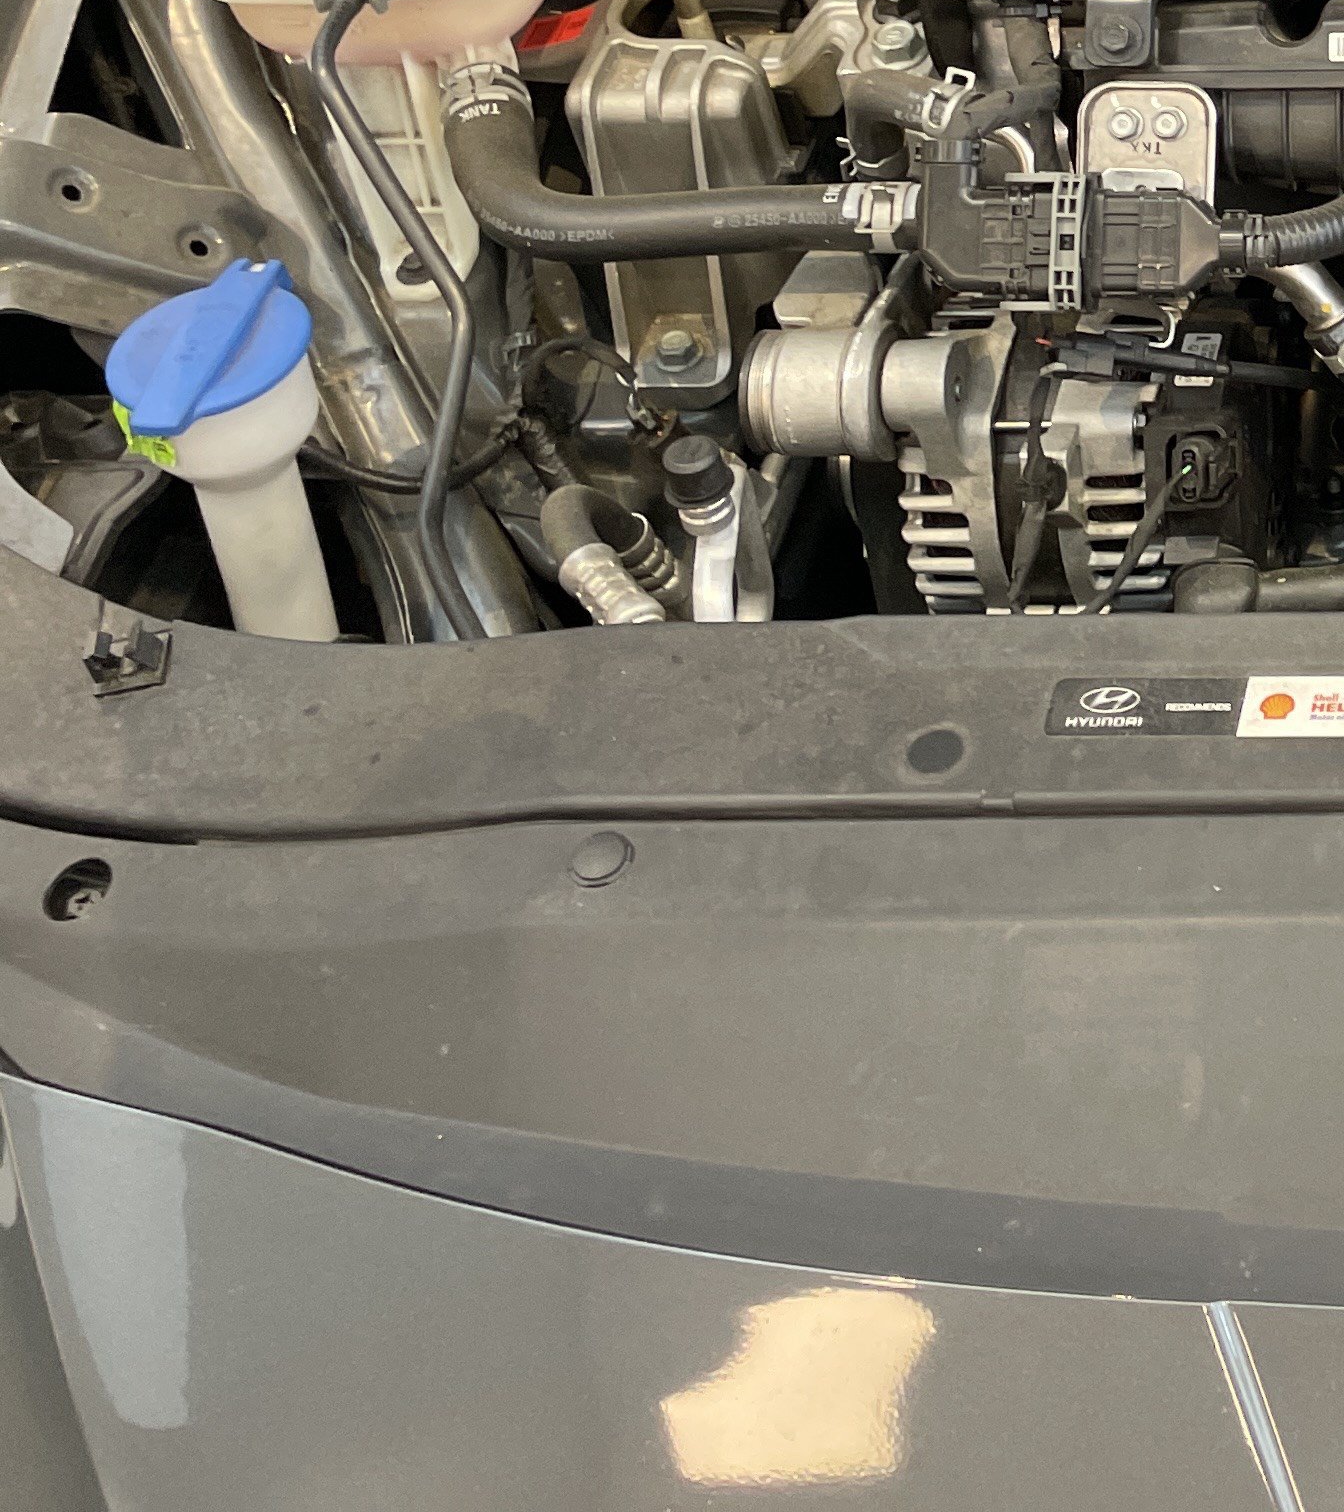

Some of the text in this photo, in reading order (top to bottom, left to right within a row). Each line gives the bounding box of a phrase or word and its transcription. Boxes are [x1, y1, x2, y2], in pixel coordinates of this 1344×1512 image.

[458, 102, 502, 124] TANK
[1313, 692, 1340, 702] Shell
[1064, 716, 1144, 728] HYUNDAI
